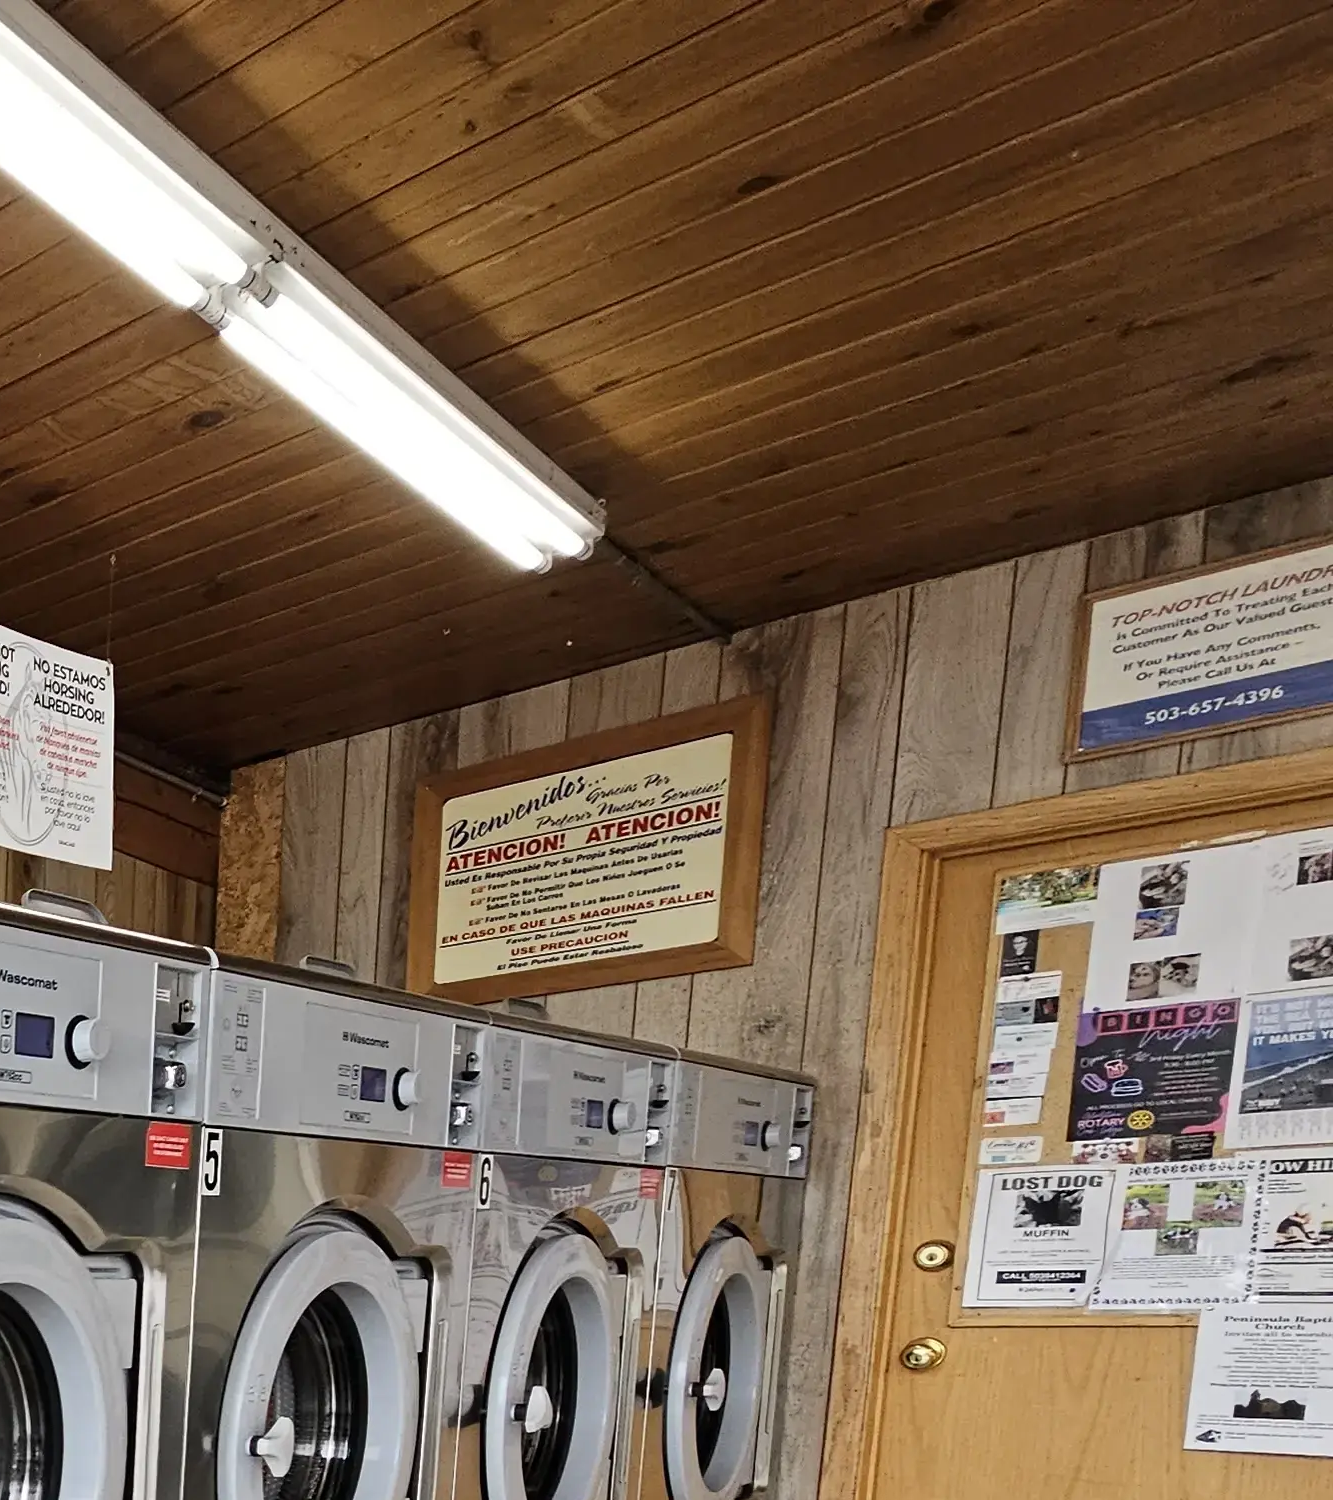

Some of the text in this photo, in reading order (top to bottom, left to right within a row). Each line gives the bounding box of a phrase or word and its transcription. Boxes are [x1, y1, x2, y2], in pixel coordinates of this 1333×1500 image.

[1112, 562, 1333, 628] TOP-NOTCH LAUNDR
[1112, 633, 1178, 654] Customer
[1181, 628, 1199, 638] As
[1203, 621, 1231, 632] Our
[1235, 606, 1285, 625] Valued
[1115, 631, 1127, 641] is
[1130, 611, 1209, 637] Committed
[1212, 607, 1230, 617] To
[1235, 592, 1297, 612] Treating
[1122, 623, 1320, 672] If You Have Any Comments,
[1135, 642, 1290, 681] Or Require Assistance
[33, 656, 106, 691] NO ESTAMOS
[1157, 657, 1276, 689] Please Call Us At
[44, 677, 94, 704] HORSING
[1144, 685, 1284, 725] 503-657-4396
[33, 692, 105, 725] ALREDEDOR!
[536, 778, 727, 829] Preferir Nuestros Servicios!
[585, 773, 671, 804] Gracias Por
[445, 802, 720, 872] ATENCION! ATENCION!
[444, 825, 723, 887] Usted Es Responsable Por Su Propia Seguridad Y Propiedad
[487, 882, 508, 891] Favor
[569, 863, 609, 875] Maquinas
[610, 858, 635, 867] Antes
[636, 855, 648, 863] De
[486, 894, 508, 903] Favor
[533, 883, 566, 894] Permitir
[567, 880, 583, 888] Que
[585, 877, 600, 885] Los
[627, 865, 663, 877] Jueguen
[674, 860, 685, 868] Se
[537, 892, 563, 901] Carros
[441, 889, 714, 944] EN CASO DE QUE LAS MAQUINAS FALLEN
[484, 914, 506, 923] Favor
[582, 898, 597, 906] Las
[598, 893, 625, 903] Mesas
[636, 883, 680, 896] Lavadoras
[505, 936, 532, 944] Favor
[604, 918, 637, 928] Forma
[510, 929, 628, 956] USE PRECAUCION
[530, 956, 560, 965] Puede
[562, 951, 589, 960] Estar
[1106, 1002, 1231, 1027] BINGO
[1253, 1036, 1266, 1046] IT
[1269, 1031, 1317, 1045] MAKES
[1077, 1117, 1126, 1130] ROTARY
[204, 1132, 220, 1191] 5
[1273, 1161, 1304, 1173] OW
[479, 1157, 491, 1206] 6
[667, 1169, 677, 1211] 7
[1001, 1174, 1104, 1191] LOST DOG
[1022, 1229, 1070, 1238] MUFFIN
[1002, 1272, 1026, 1280] CALL
[1224, 1315, 1333, 1324] Peninsula Bapti
[1255, 1323, 1305, 1331] Church
